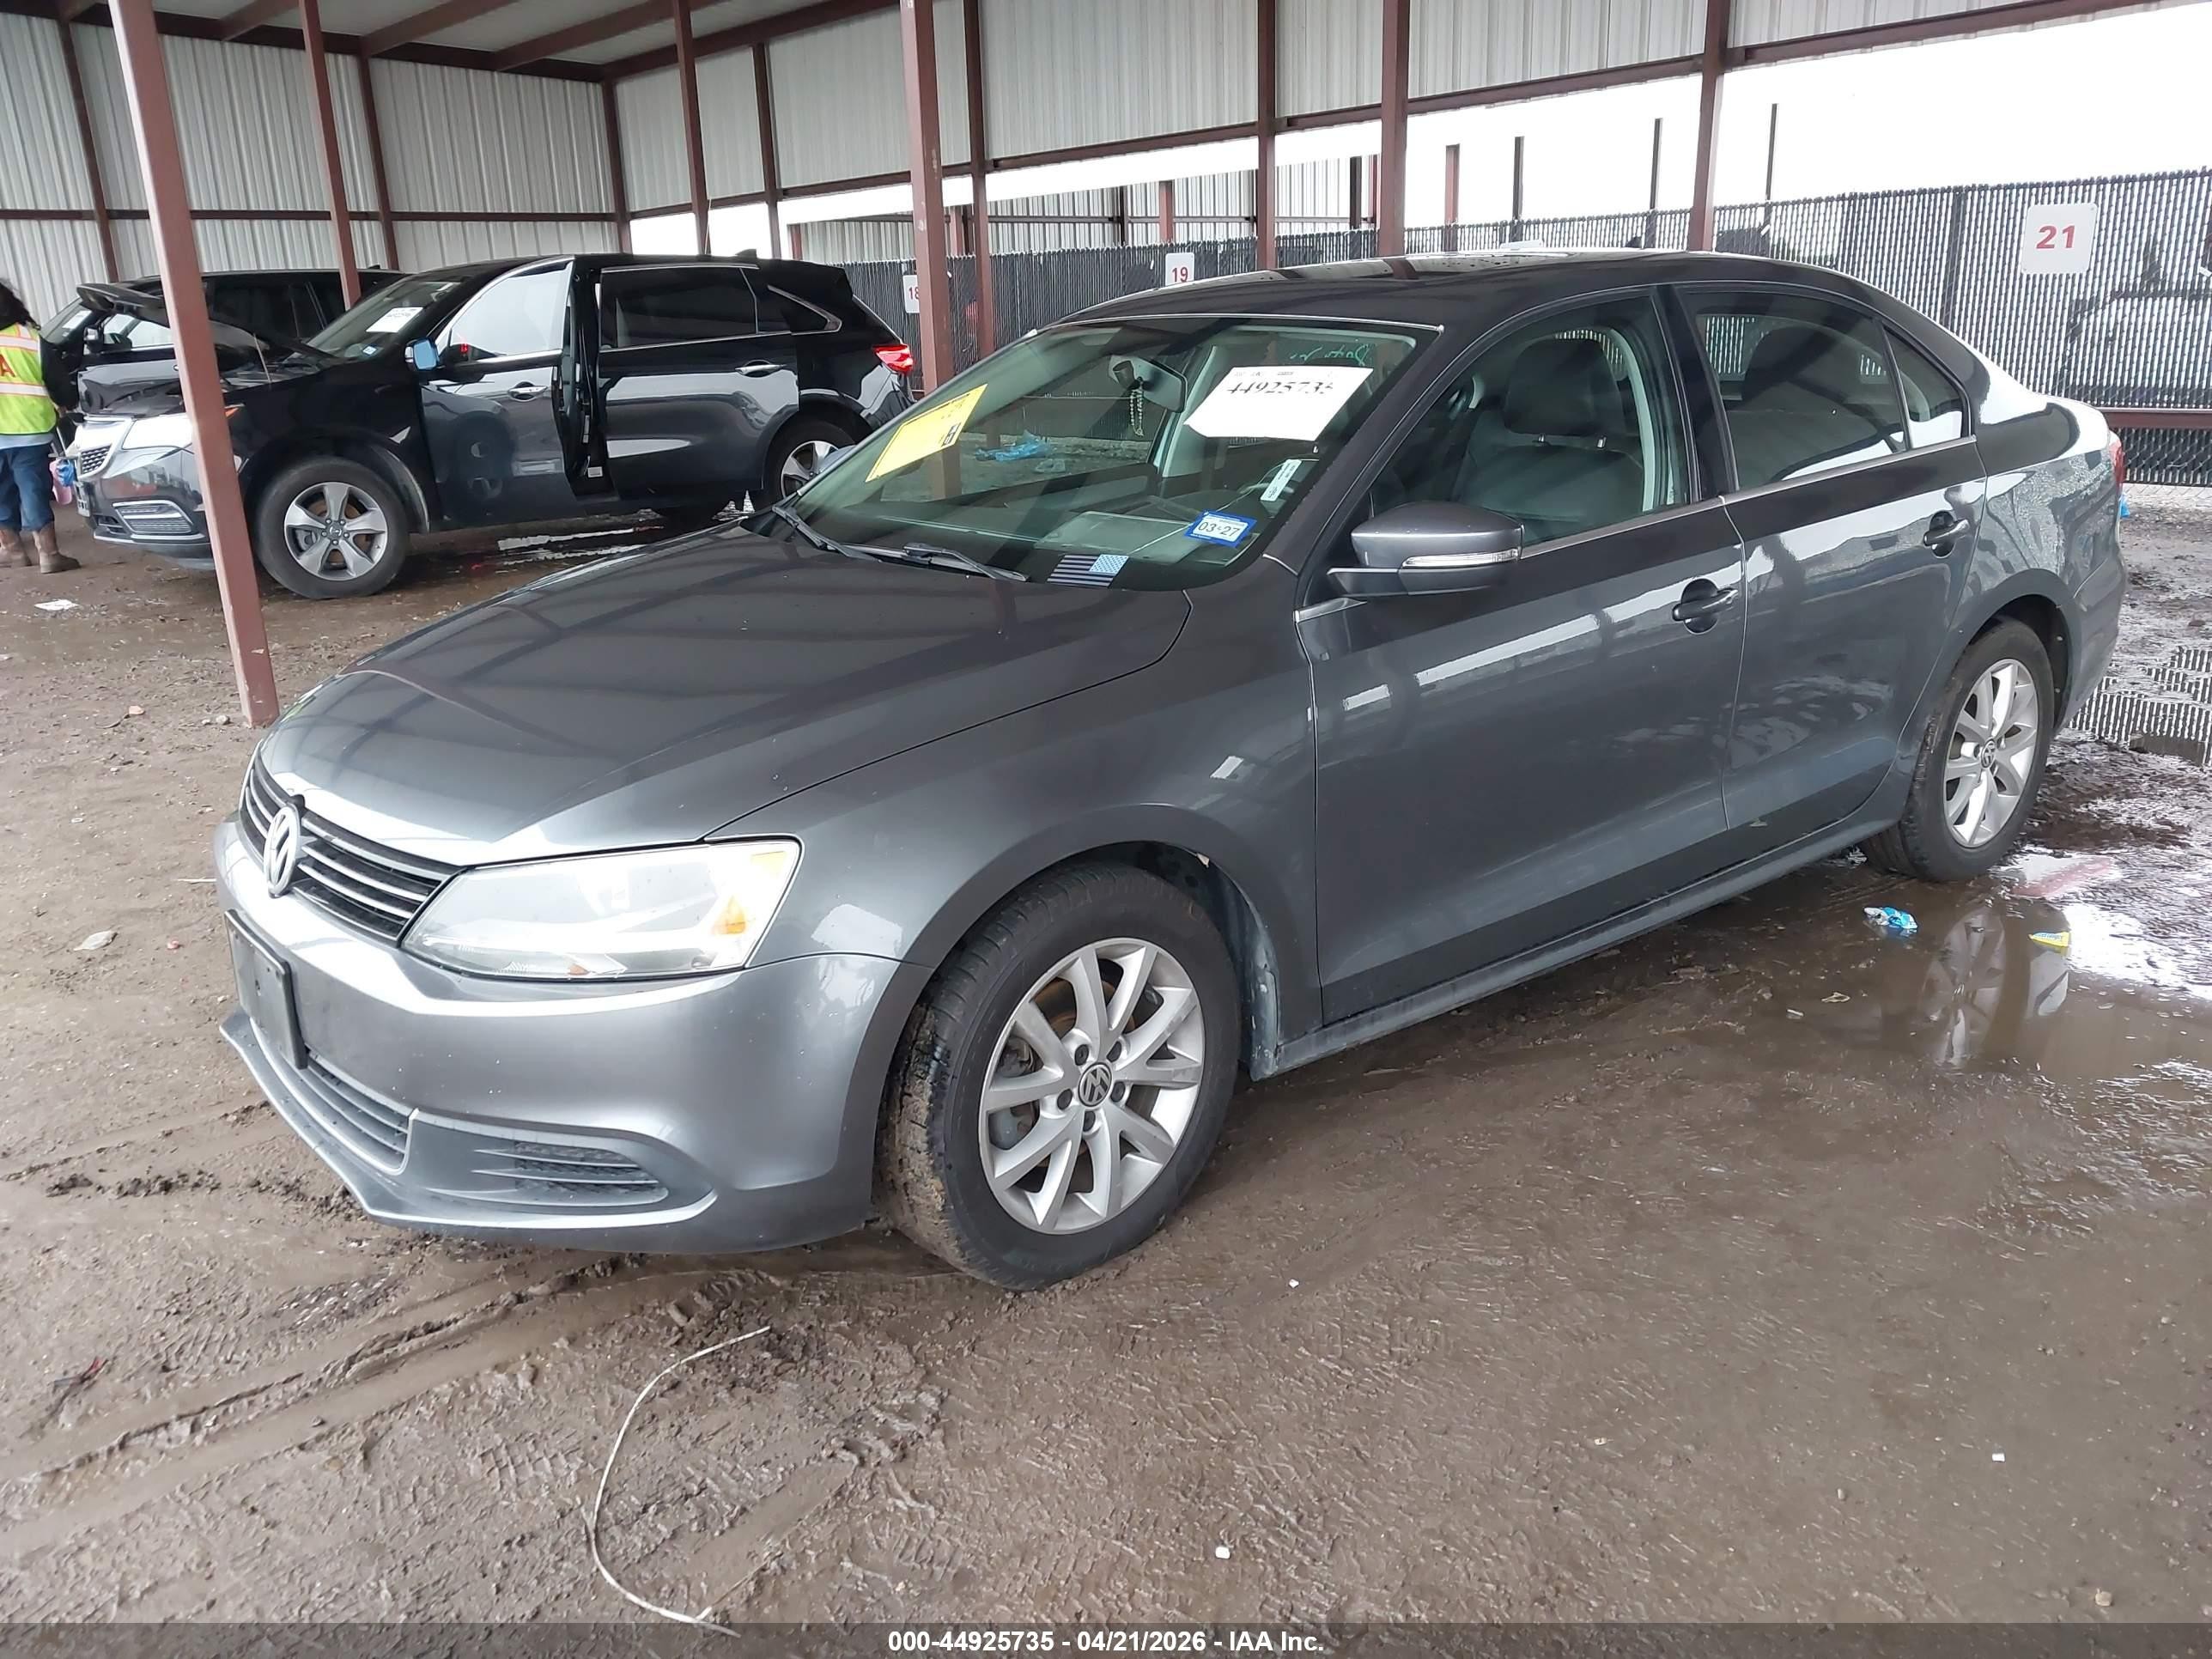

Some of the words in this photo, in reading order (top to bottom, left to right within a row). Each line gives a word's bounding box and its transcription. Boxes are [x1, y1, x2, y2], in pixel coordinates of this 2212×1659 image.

[2036, 225, 2075, 249] 21
[1172, 266, 1188, 283] 19
[1198, 521, 1217, 532] 03
[1219, 526, 1240, 537] 27
